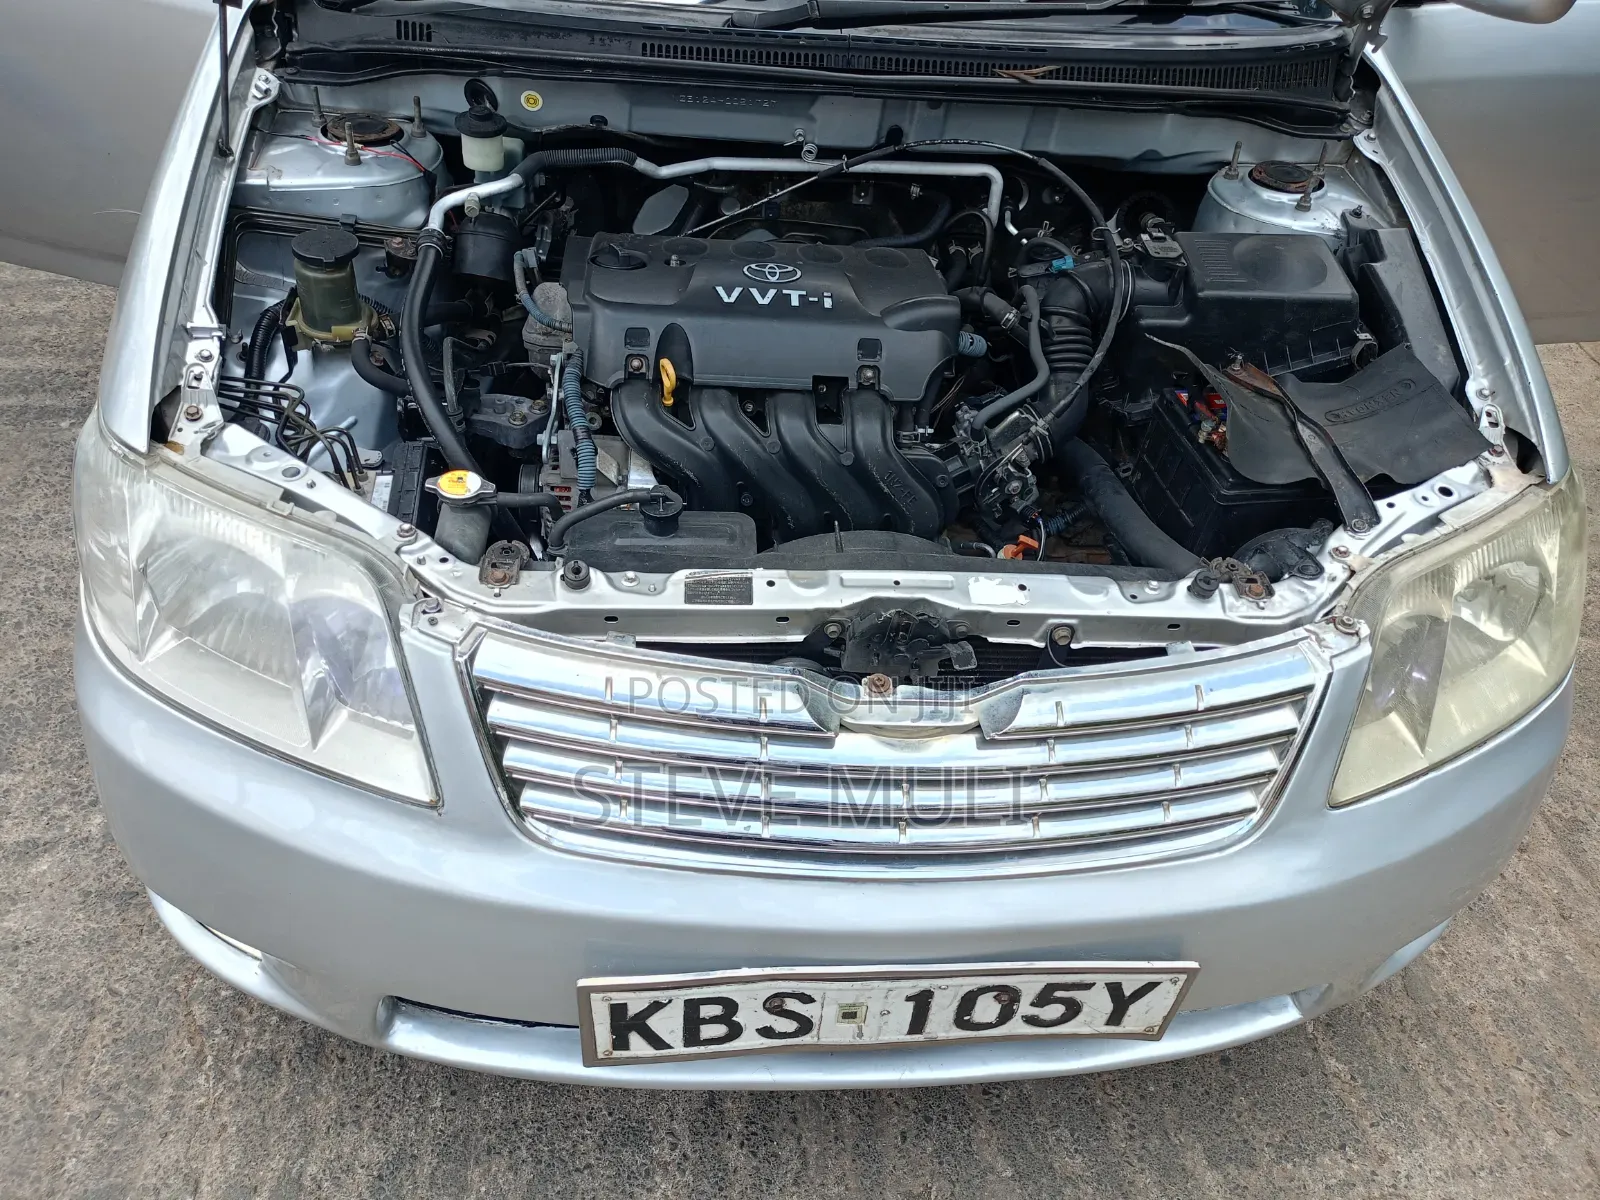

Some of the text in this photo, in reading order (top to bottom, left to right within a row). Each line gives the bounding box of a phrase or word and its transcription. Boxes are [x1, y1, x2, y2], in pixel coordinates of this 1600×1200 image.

[714, 285, 833, 309] VVT-i
[609, 981, 1163, 1051] KBS 105Y
